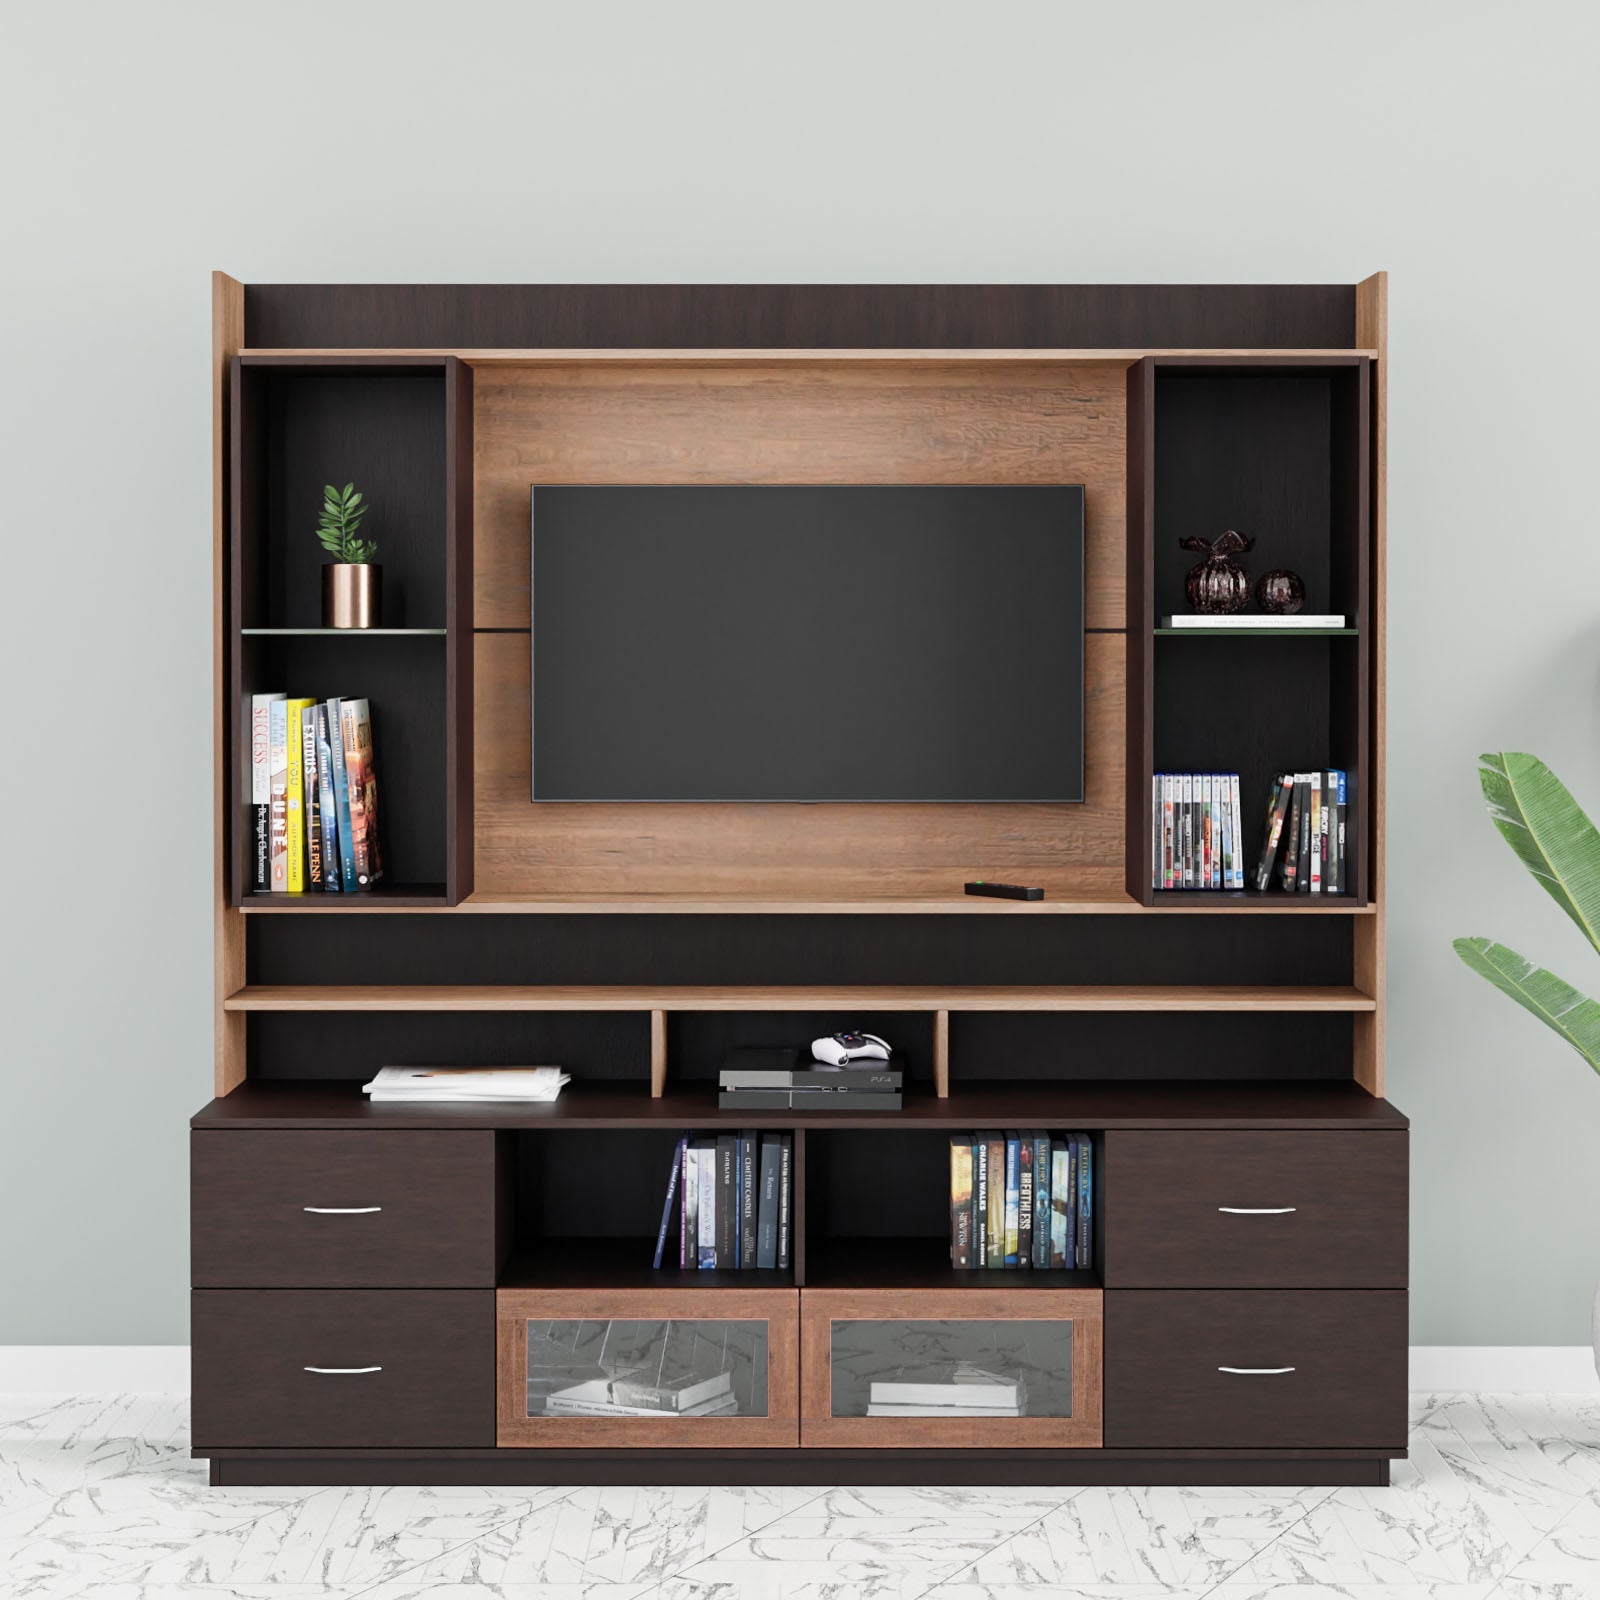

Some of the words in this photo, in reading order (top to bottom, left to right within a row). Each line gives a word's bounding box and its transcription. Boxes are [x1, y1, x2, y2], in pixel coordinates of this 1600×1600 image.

[254, 707, 268, 764] SUCCESS
[303, 724, 316, 774] EXODUS
[290, 761, 298, 786] YOU
[272, 784, 286, 848] DUNE
[311, 838, 319, 851] LE
[312, 853, 320, 883] PENN
[744, 1157, 752, 1188] CEMETERY
[979, 1145, 987, 1181] CHARLIE
[1039, 1144, 1047, 1183] MERCURY
[744, 1188, 752, 1219] CANDLES
[766, 1177, 775, 1200] Return
[979, 1182, 987, 1211] WALKS
[1019, 1172, 1032, 1230] BREATHLESS
